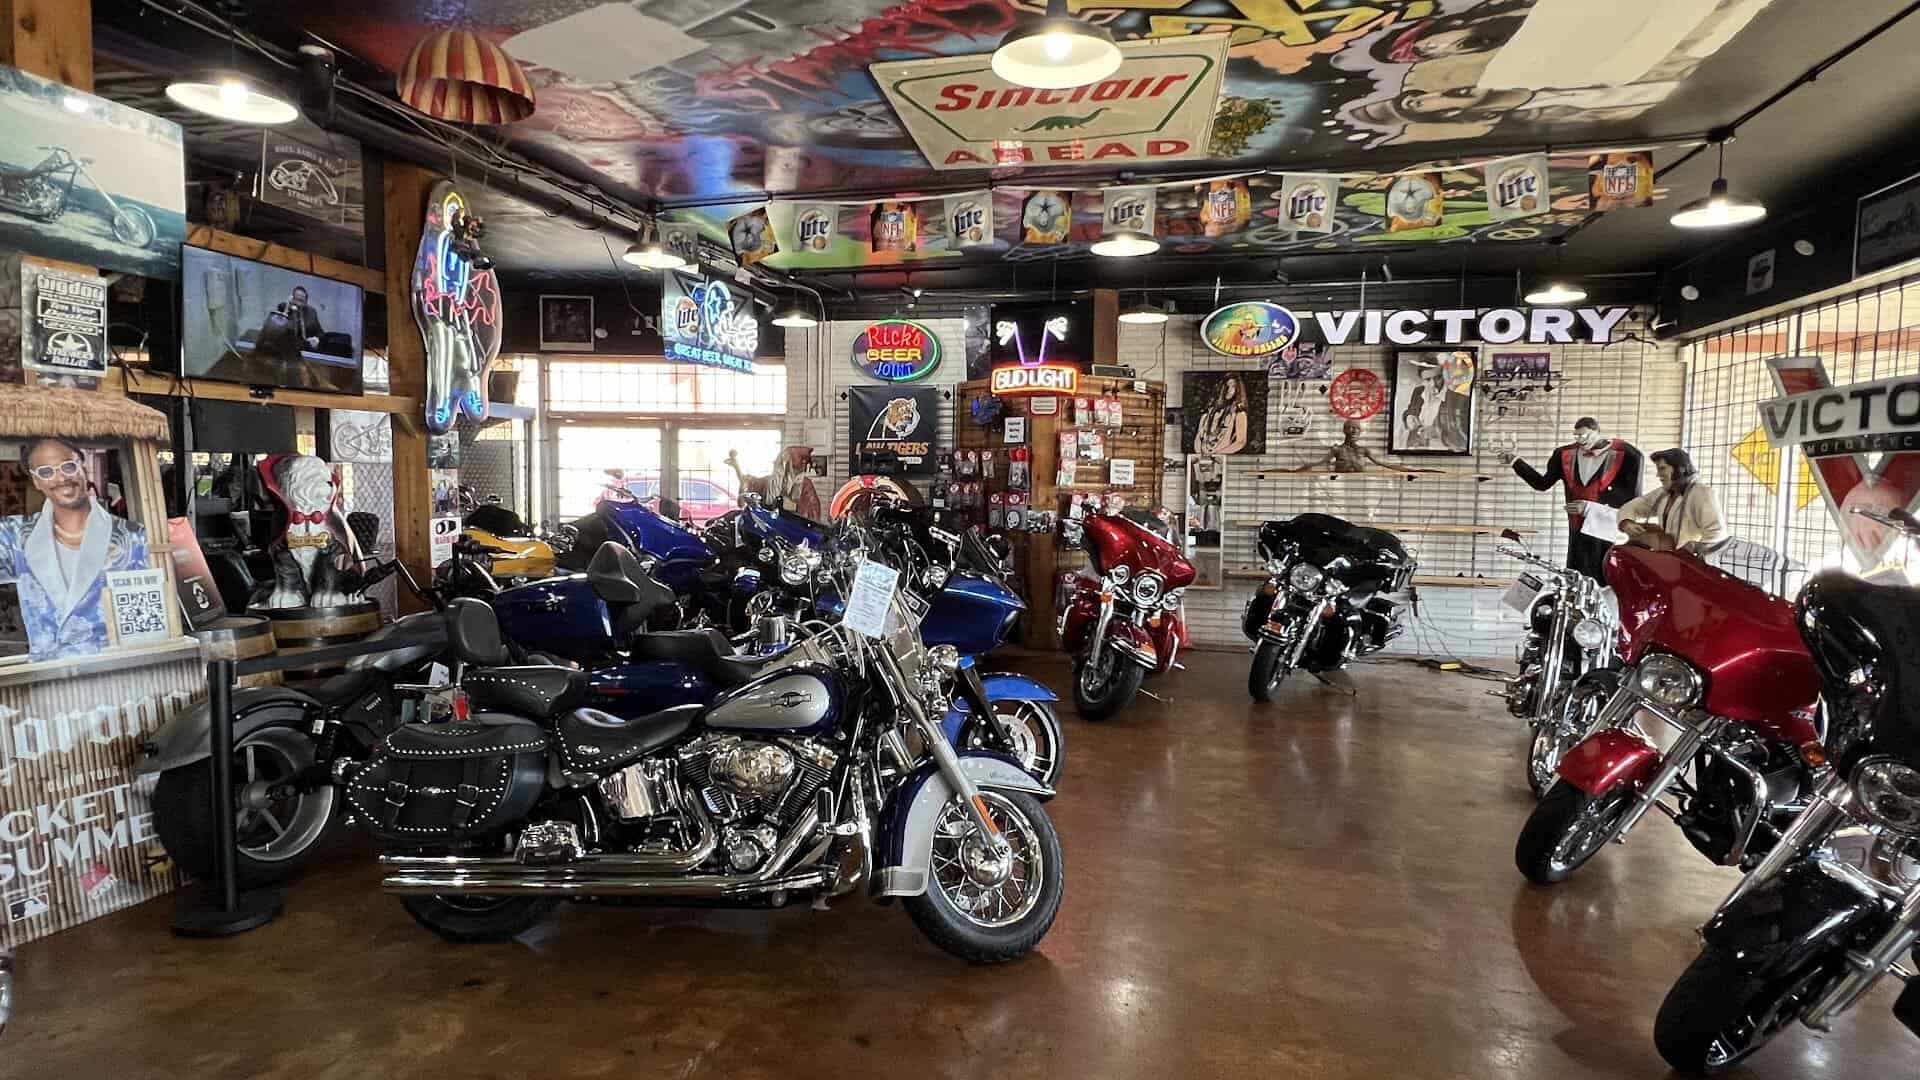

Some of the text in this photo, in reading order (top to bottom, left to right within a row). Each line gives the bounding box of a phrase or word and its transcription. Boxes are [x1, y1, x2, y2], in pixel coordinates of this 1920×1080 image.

[935, 74, 1188, 112] Sinclair
[944, 140, 1190, 165] AHEAD
[1499, 175, 1536, 208] Lite
[1607, 178, 1635, 192] NFL
[1214, 203, 1234, 217] NFL
[1291, 194, 1326, 220] Lite
[800, 218, 830, 243] Lite
[880, 222, 905, 237] NFL
[953, 209, 983, 237] Lite
[864, 325, 921, 348] Rick's
[1315, 307, 1631, 345] VICTORY
[866, 348, 923, 362] BEER
[873, 361, 913, 377] JOINT
[995, 367, 1073, 390] BUD LIGHT
[1766, 381, 1920, 440] VICTO
[887, 442, 929, 456] TIGERS
[90, 767, 120, 783] YOUR
